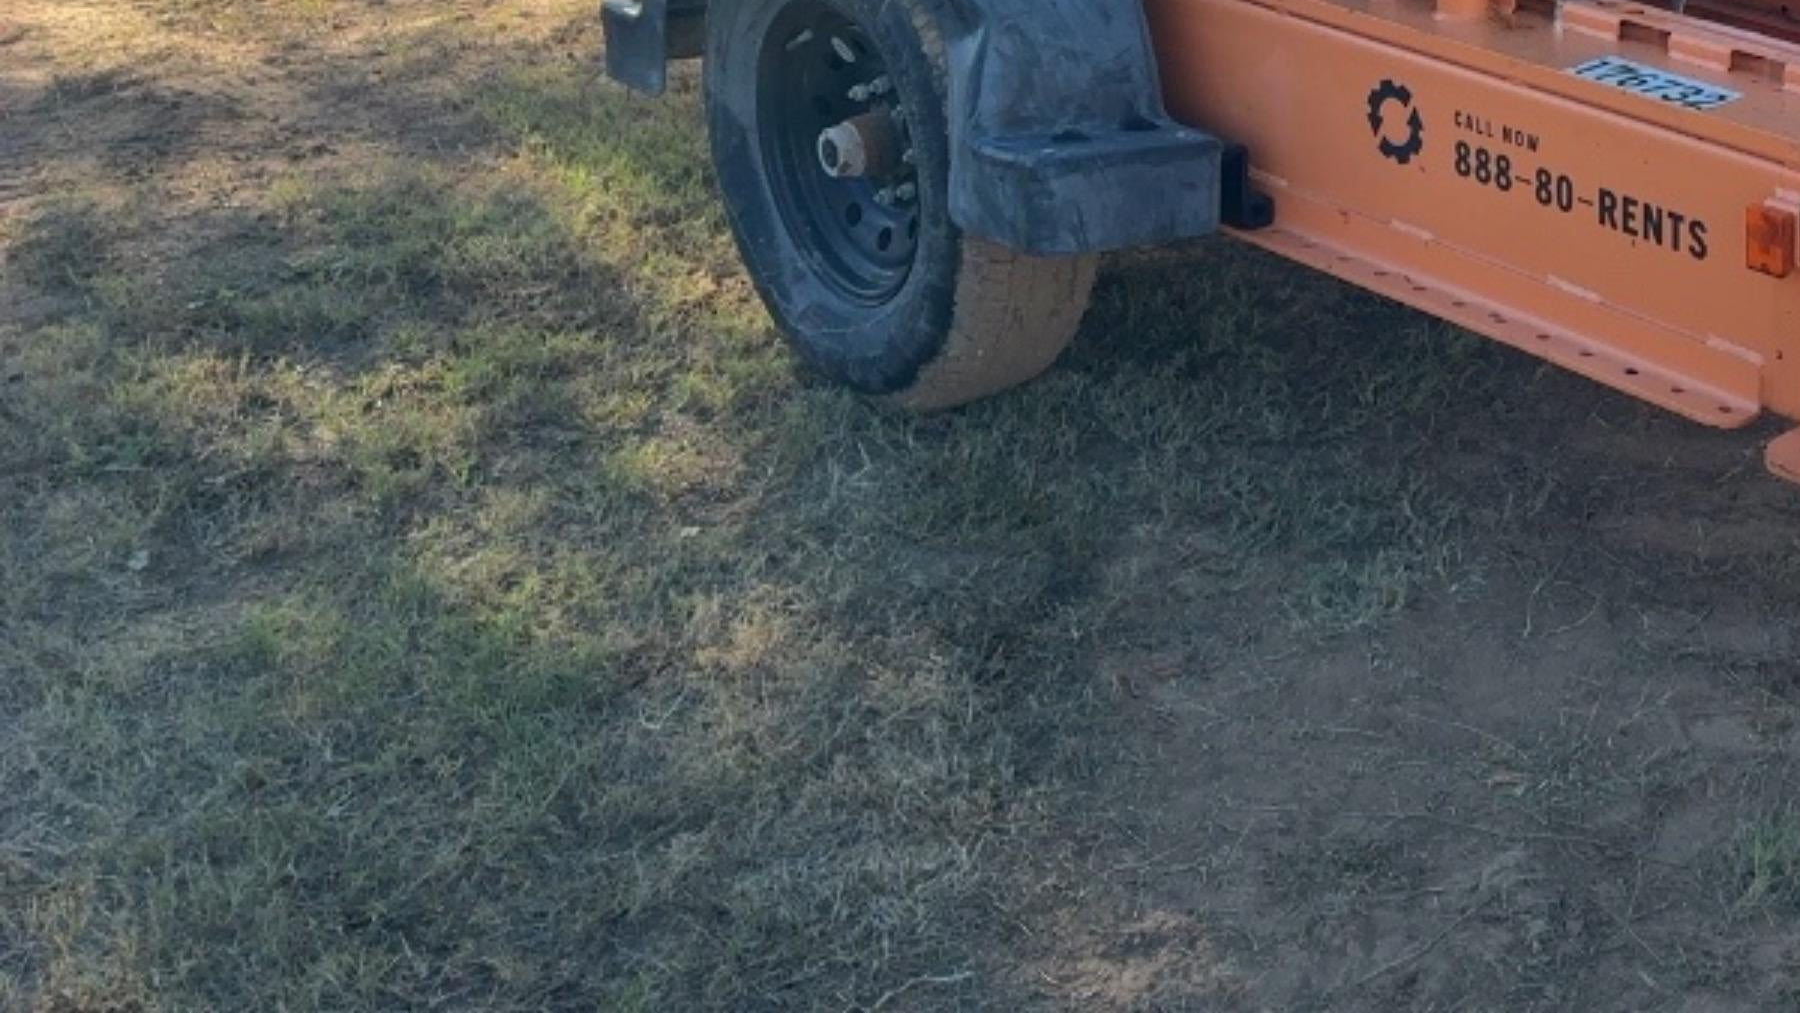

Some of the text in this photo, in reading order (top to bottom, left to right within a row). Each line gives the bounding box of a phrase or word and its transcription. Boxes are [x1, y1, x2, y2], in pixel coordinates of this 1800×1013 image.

[1573, 60, 1729, 111] 176732
[1454, 109, 1540, 153] CALL NOW
[1454, 139, 1708, 261] 888-80-RENTS
